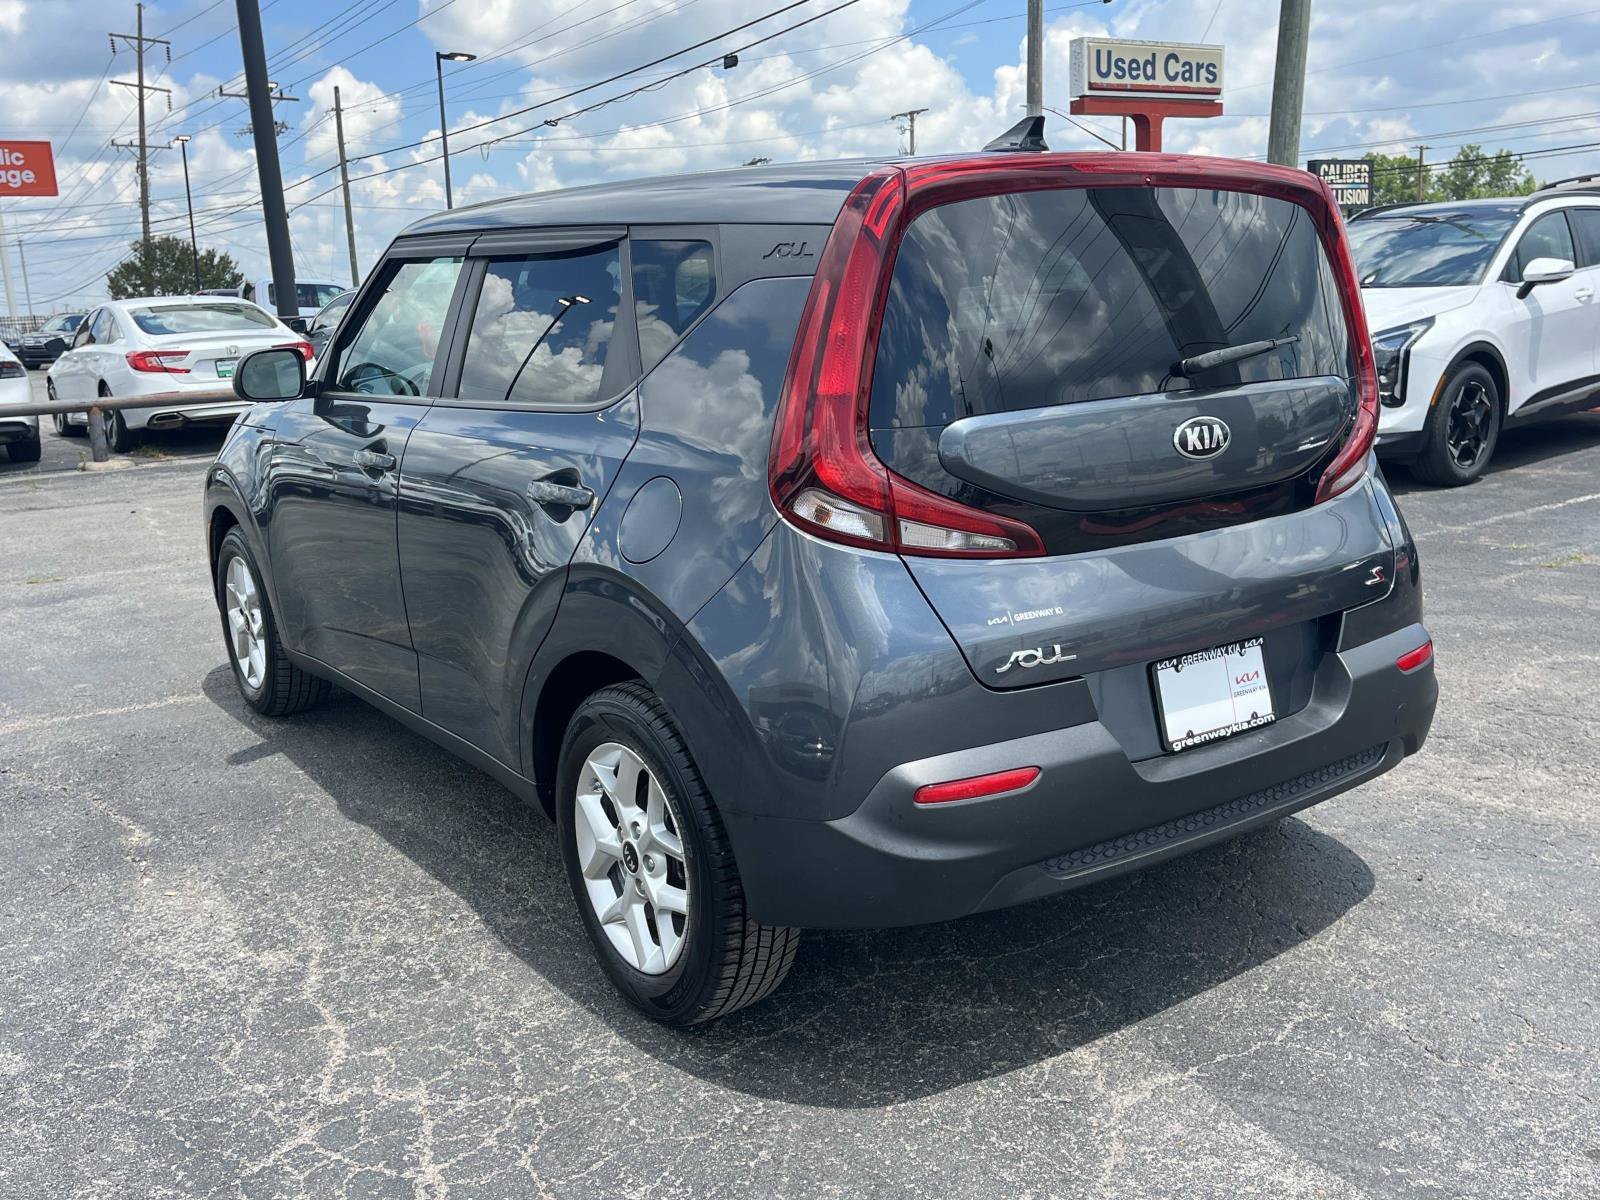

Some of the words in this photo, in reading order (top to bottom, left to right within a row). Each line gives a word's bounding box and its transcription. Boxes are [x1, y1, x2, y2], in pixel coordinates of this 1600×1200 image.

[1095, 48, 1157, 81] Used
[1163, 52, 1218, 84] Cars
[1320, 164, 1369, 183] CALIBER
[762, 241, 814, 260] SOUL
[1185, 424, 1225, 451] KIA
[1013, 606, 1054, 622] GREENWAY
[995, 644, 1077, 674] SOUL
[1181, 646, 1227, 667] GREENWAY
[1228, 642, 1241, 656] KIA
[1233, 687, 1258, 698] GREENWAY
[1171, 713, 1275, 751] greenwaykia.com
